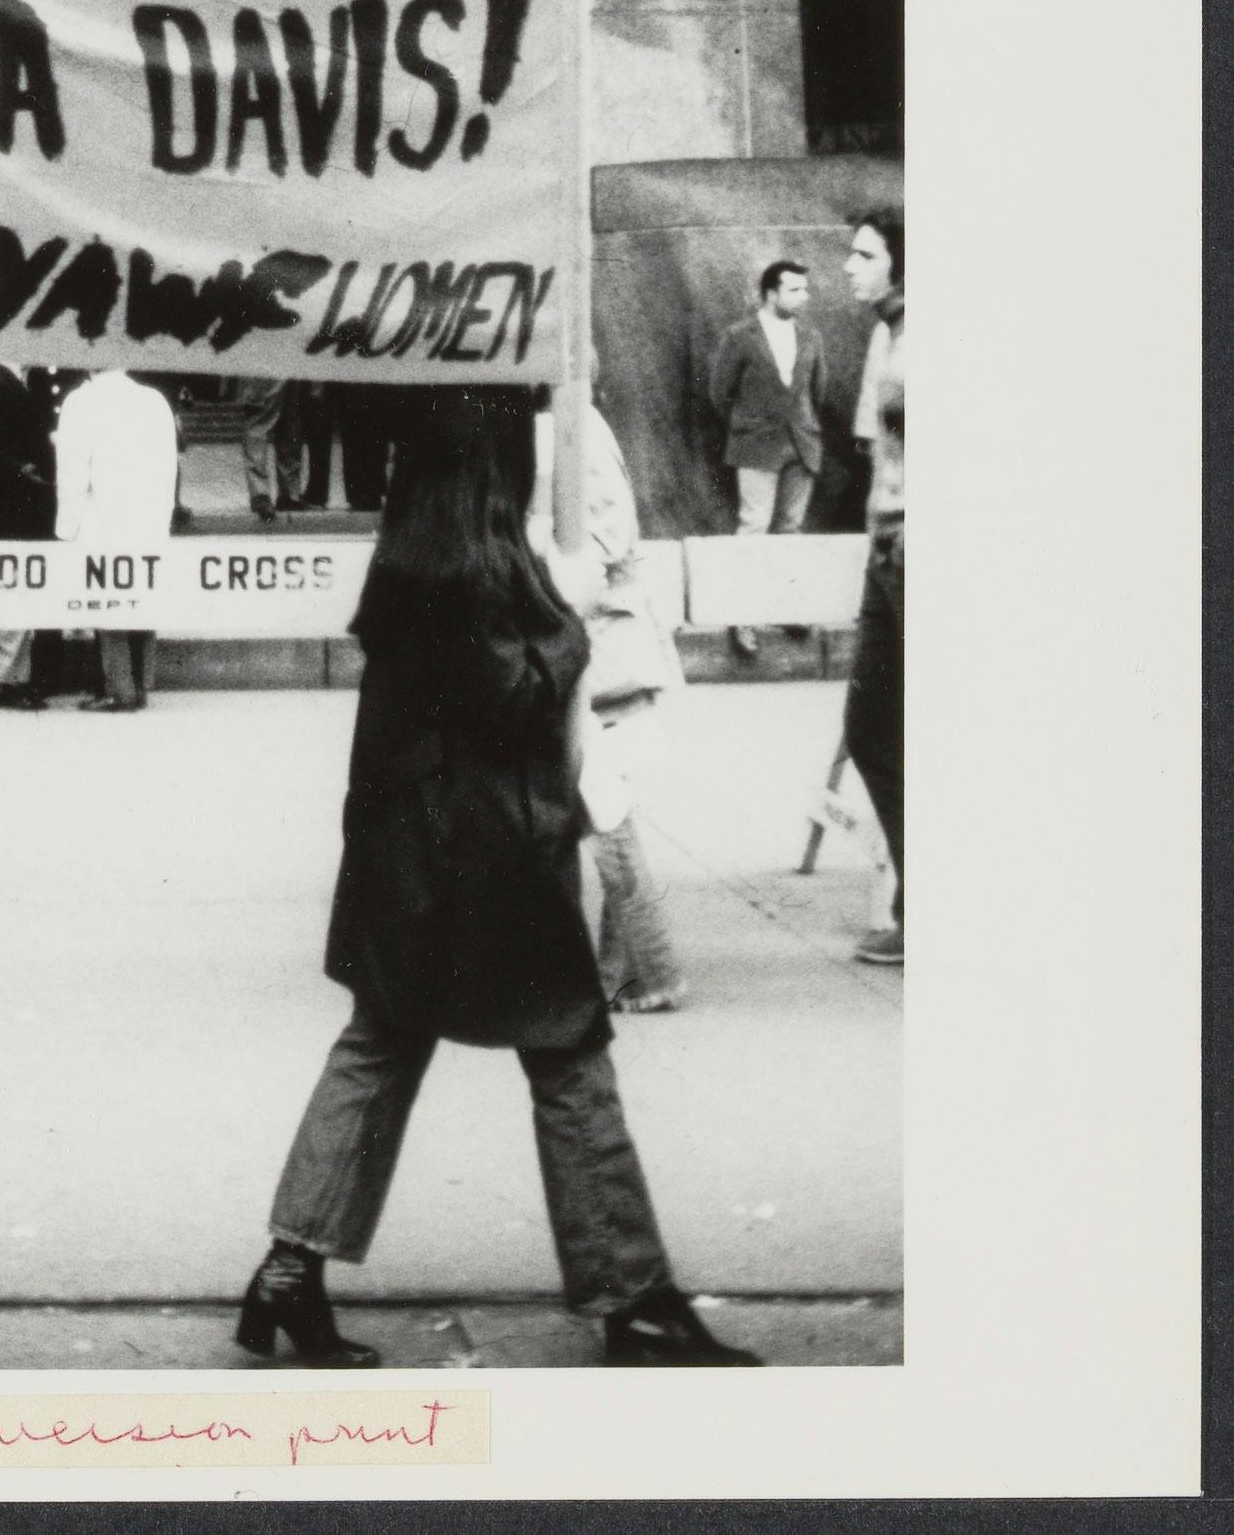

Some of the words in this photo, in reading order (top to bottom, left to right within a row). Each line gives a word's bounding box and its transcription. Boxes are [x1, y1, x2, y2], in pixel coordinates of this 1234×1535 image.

[306, 261, 555, 364] WOMEN
[85, 554, 162, 590] NOT
[199, 555, 334, 591] CROSS
[67, 598, 140, 611] DEPT
[286, 1398, 451, 1467] print
